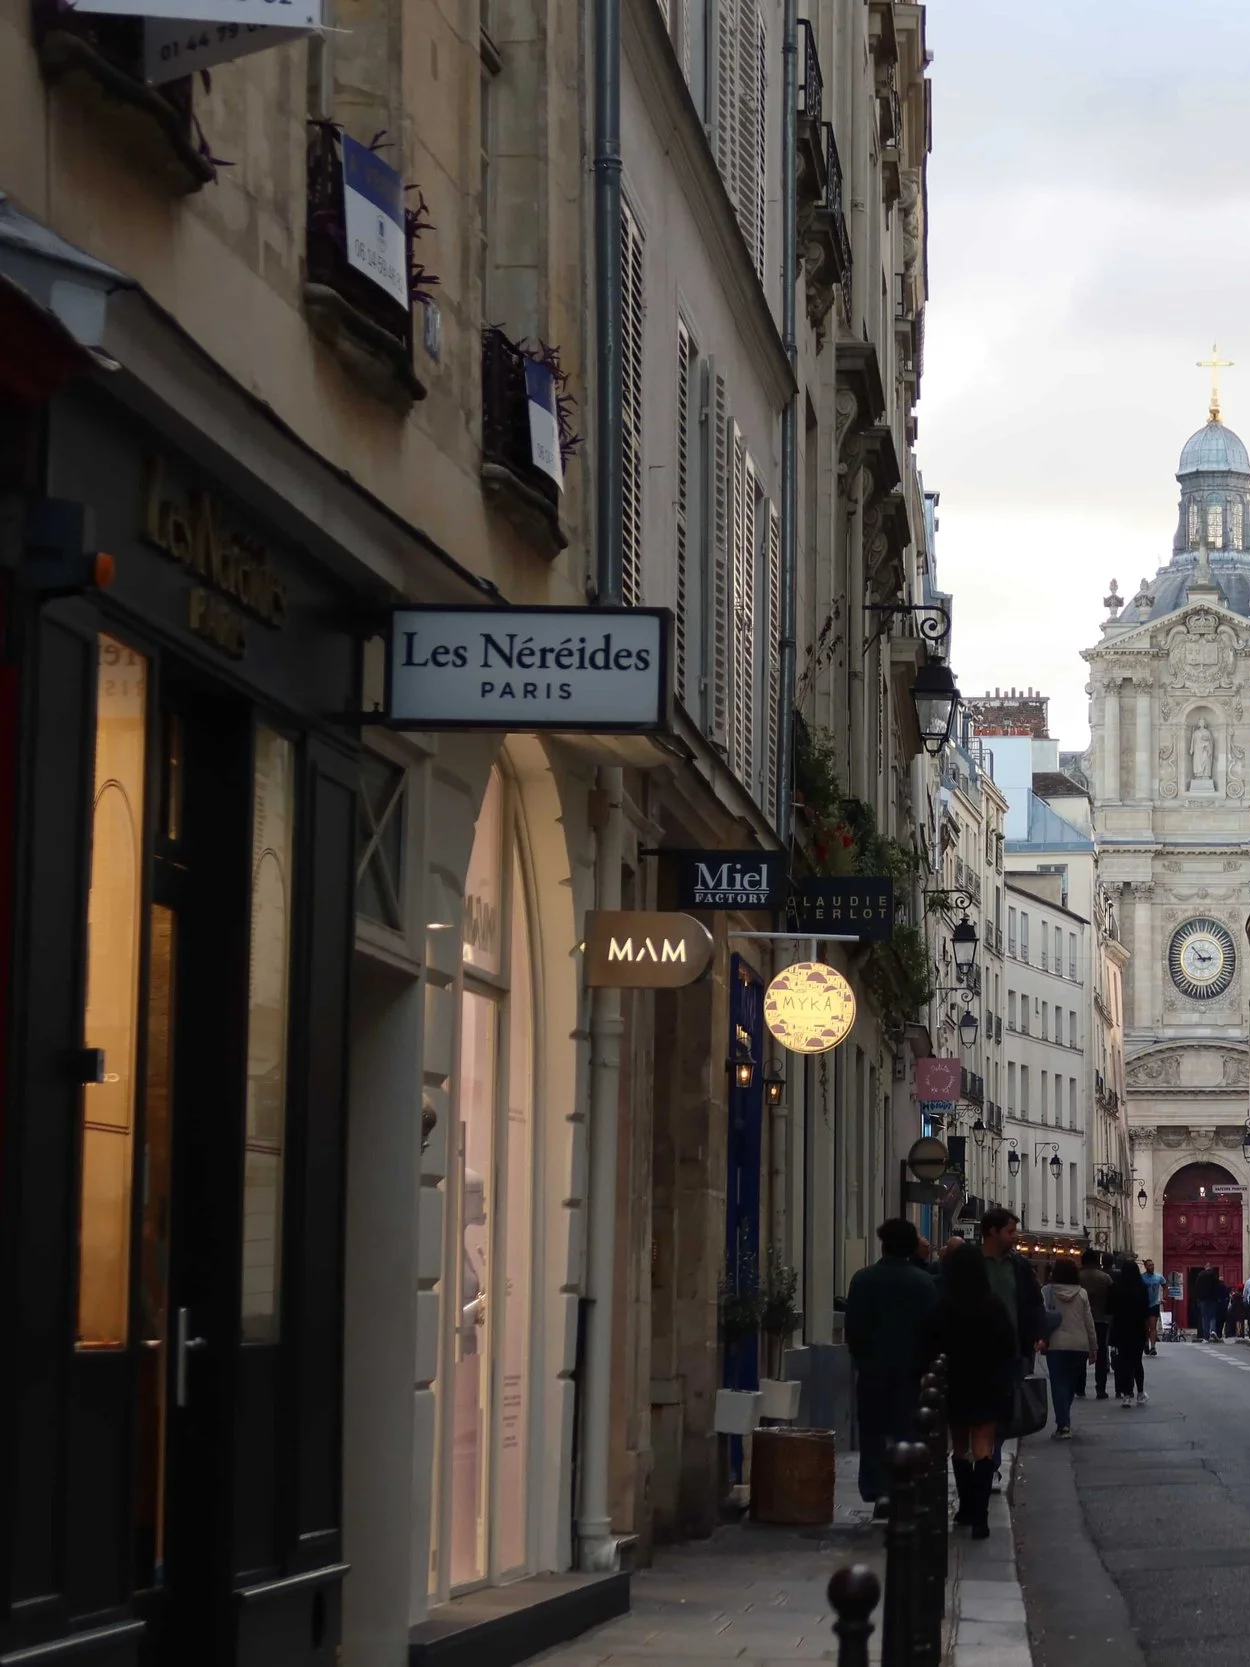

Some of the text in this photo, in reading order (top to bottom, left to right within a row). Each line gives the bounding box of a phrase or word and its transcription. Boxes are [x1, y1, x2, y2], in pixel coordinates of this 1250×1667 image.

[161, 42, 179, 61] 01
[186, 34, 210, 52] 44
[402, 631, 651, 671] Les Néréides
[480, 682, 573, 700] PARIS
[694, 862, 769, 890] Miel
[694, 893, 769, 904] FACTORY
[608, 937, 687, 962] MAM
[782, 996, 832, 1012] MYKA
